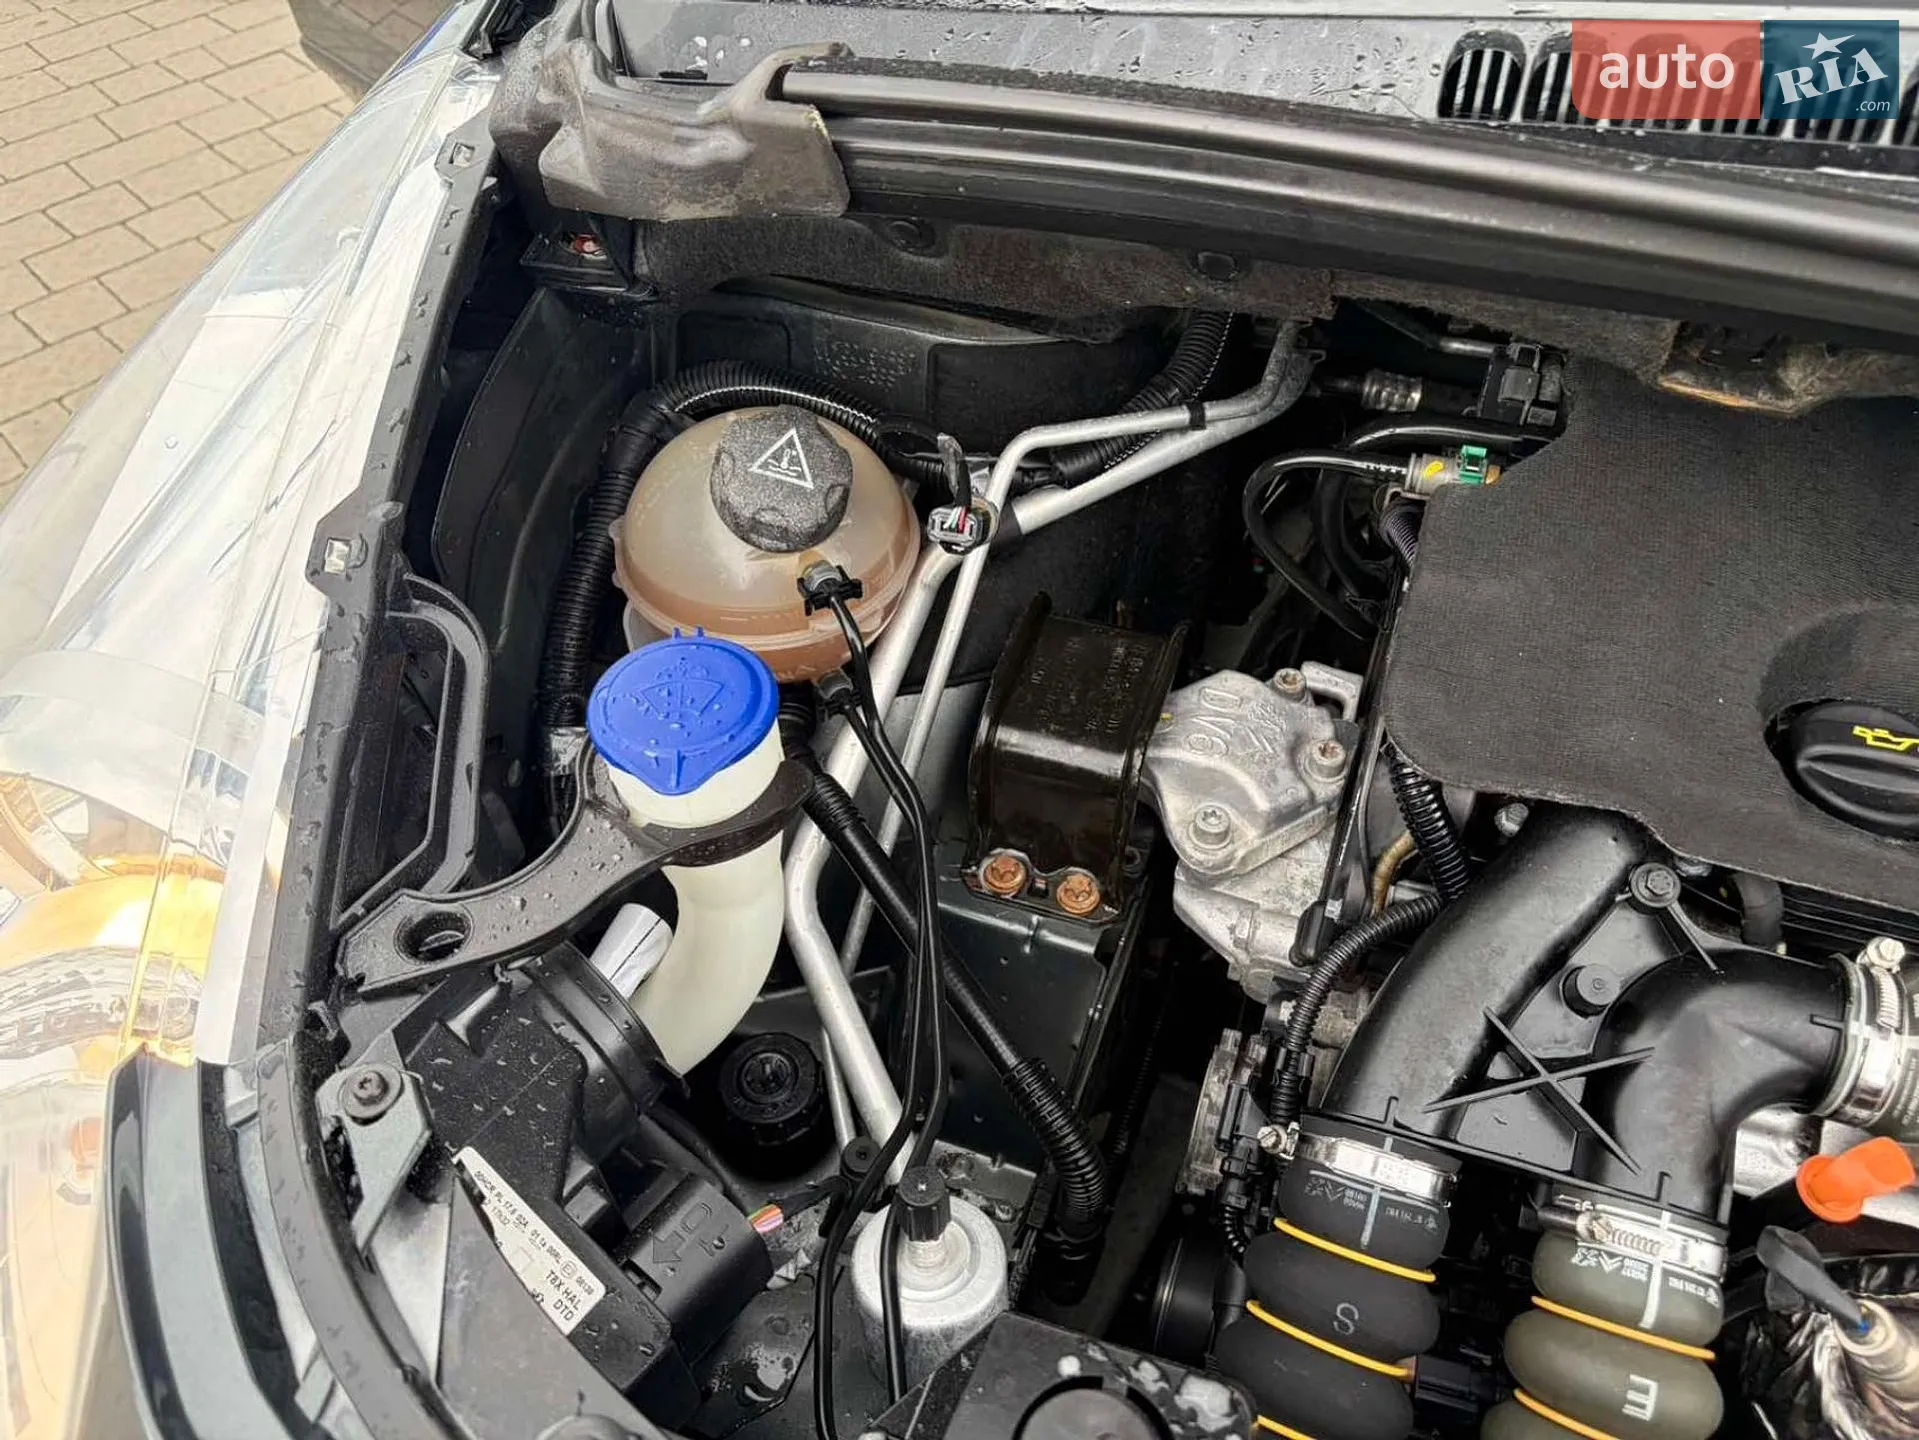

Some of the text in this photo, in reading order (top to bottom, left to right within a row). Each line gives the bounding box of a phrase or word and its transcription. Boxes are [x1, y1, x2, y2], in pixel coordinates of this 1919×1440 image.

[545, 1270, 563, 1293] T8X
[561, 1286, 583, 1312] HAL
[552, 1298, 575, 1322] DTD
